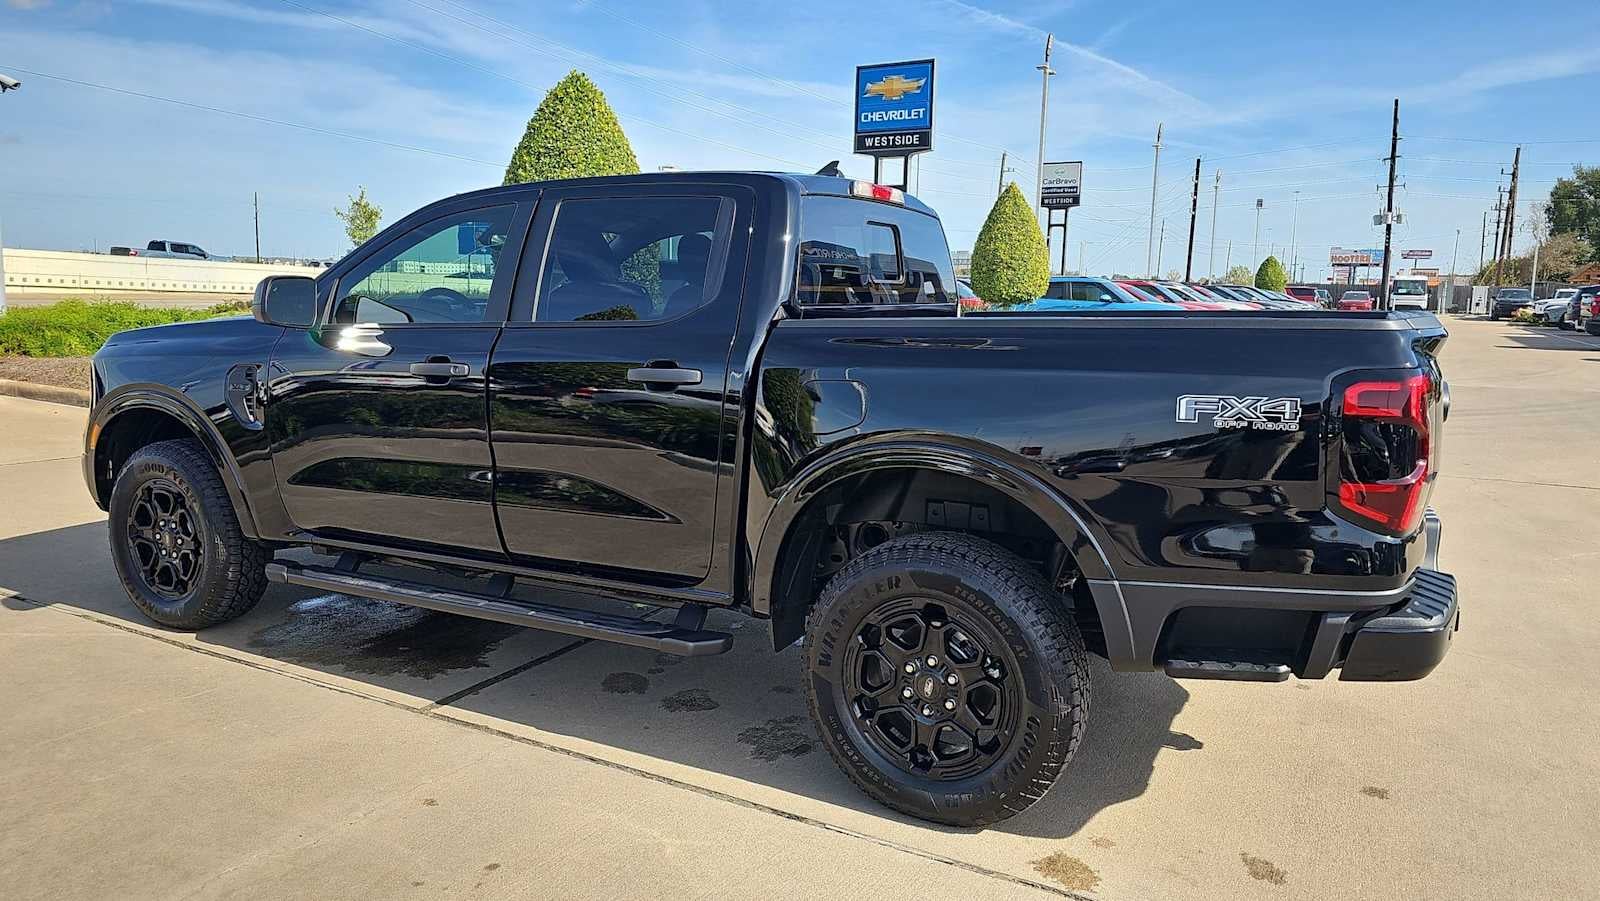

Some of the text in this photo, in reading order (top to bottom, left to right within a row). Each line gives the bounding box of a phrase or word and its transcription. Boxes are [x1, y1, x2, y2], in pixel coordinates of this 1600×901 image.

[861, 108, 926, 123] CHEVROLET
[865, 134, 920, 147] WESTSIDE
[1176, 394, 1302, 423] FX4
[1213, 420, 1300, 431] OFF ROAD
